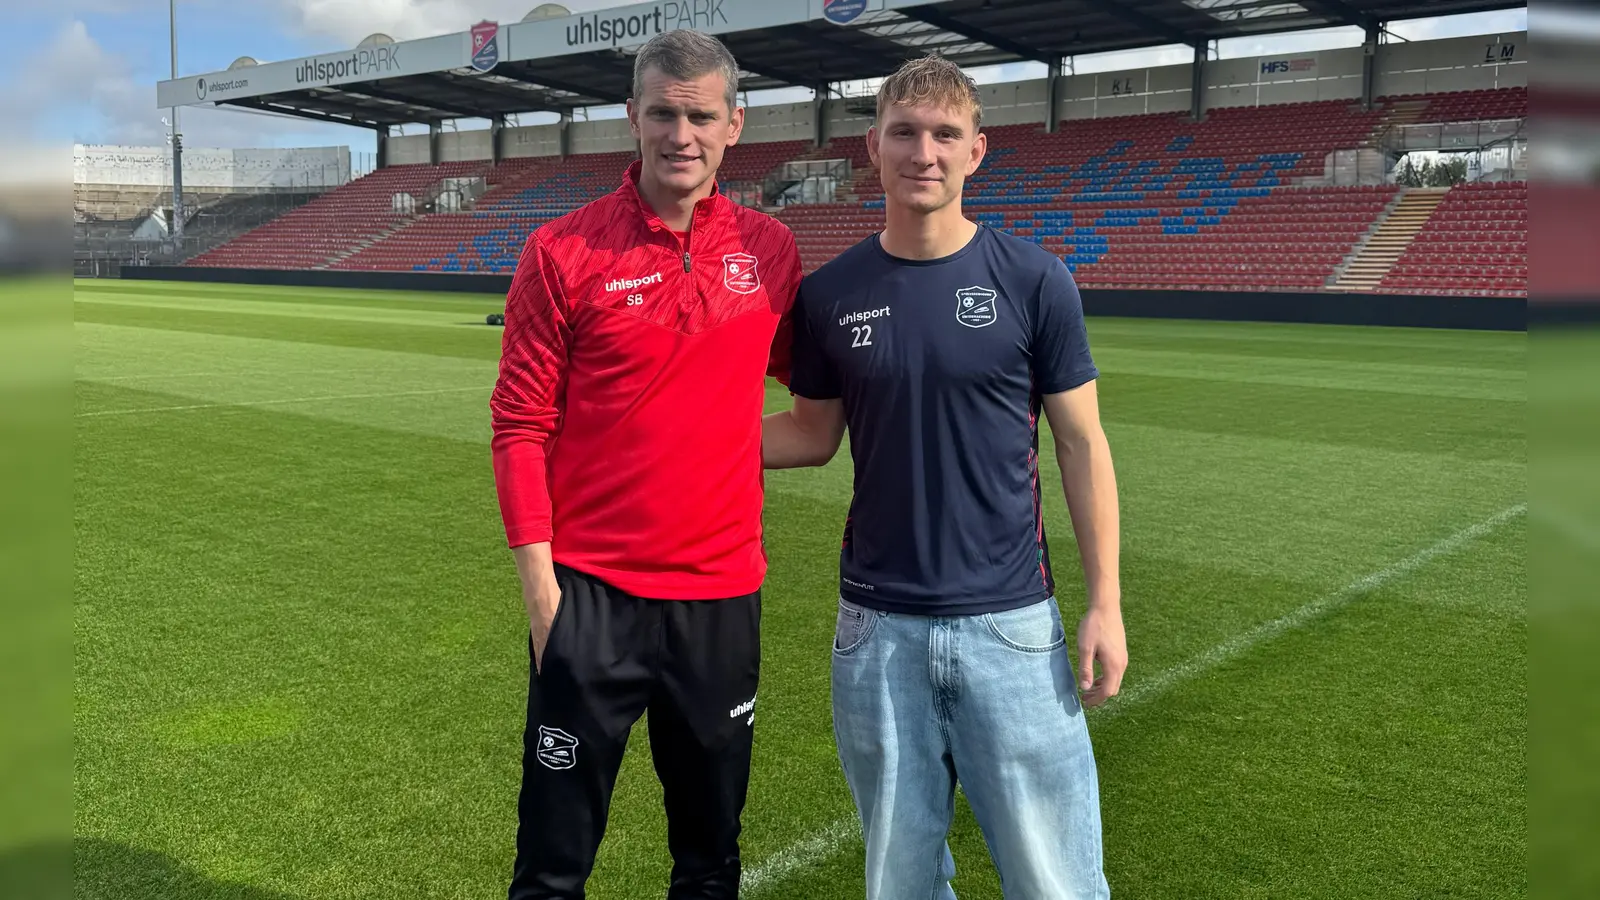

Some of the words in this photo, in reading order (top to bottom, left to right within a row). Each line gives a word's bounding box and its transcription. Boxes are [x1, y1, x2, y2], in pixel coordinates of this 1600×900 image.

[1501, 45, 1515, 58] M
[295, 46, 400, 84] uhlsportPARK
[1261, 61, 1289, 74] HFS
[208, 78, 248, 93] uhlsport.com
[605, 271, 662, 293] uhlsport
[626, 293, 644, 307] SB
[839, 305, 891, 326] uhlsport
[851, 324, 872, 348] 22
